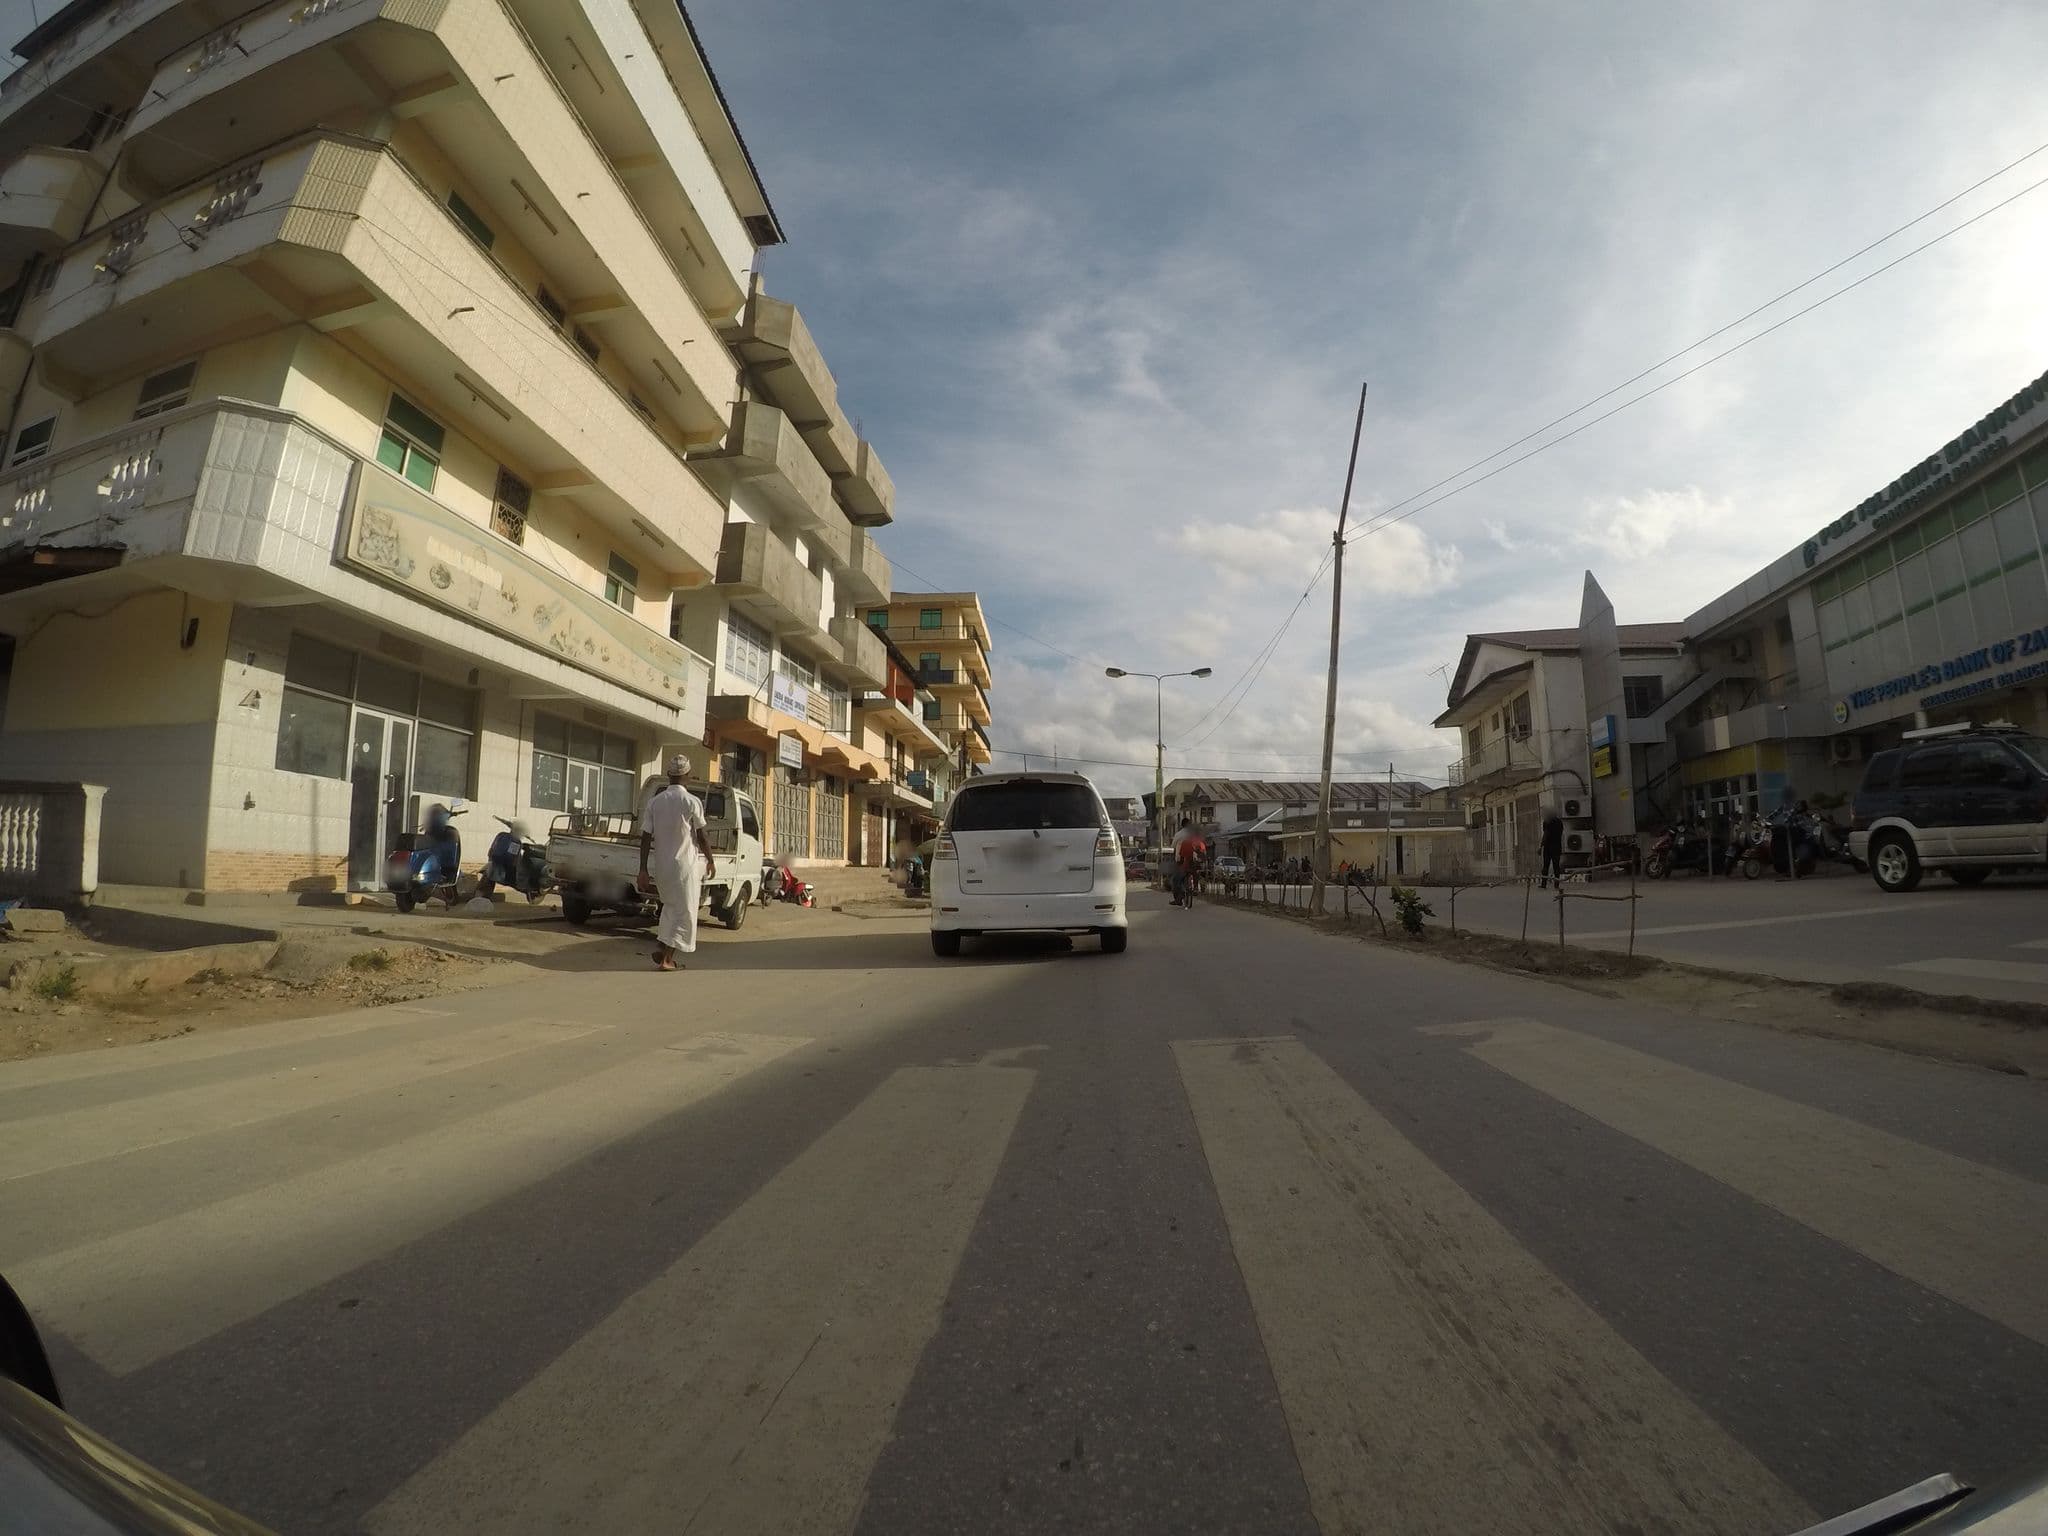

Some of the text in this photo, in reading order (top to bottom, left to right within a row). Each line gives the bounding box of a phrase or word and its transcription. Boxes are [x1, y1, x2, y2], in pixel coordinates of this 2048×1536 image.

[1857, 455, 1943, 521] ISLAMIC
[1849, 686, 1877, 709] THE
[1877, 664, 1942, 703] PEOPLE'S
[1943, 648, 1991, 681] BANK
[1991, 637, 2017, 664] OF
